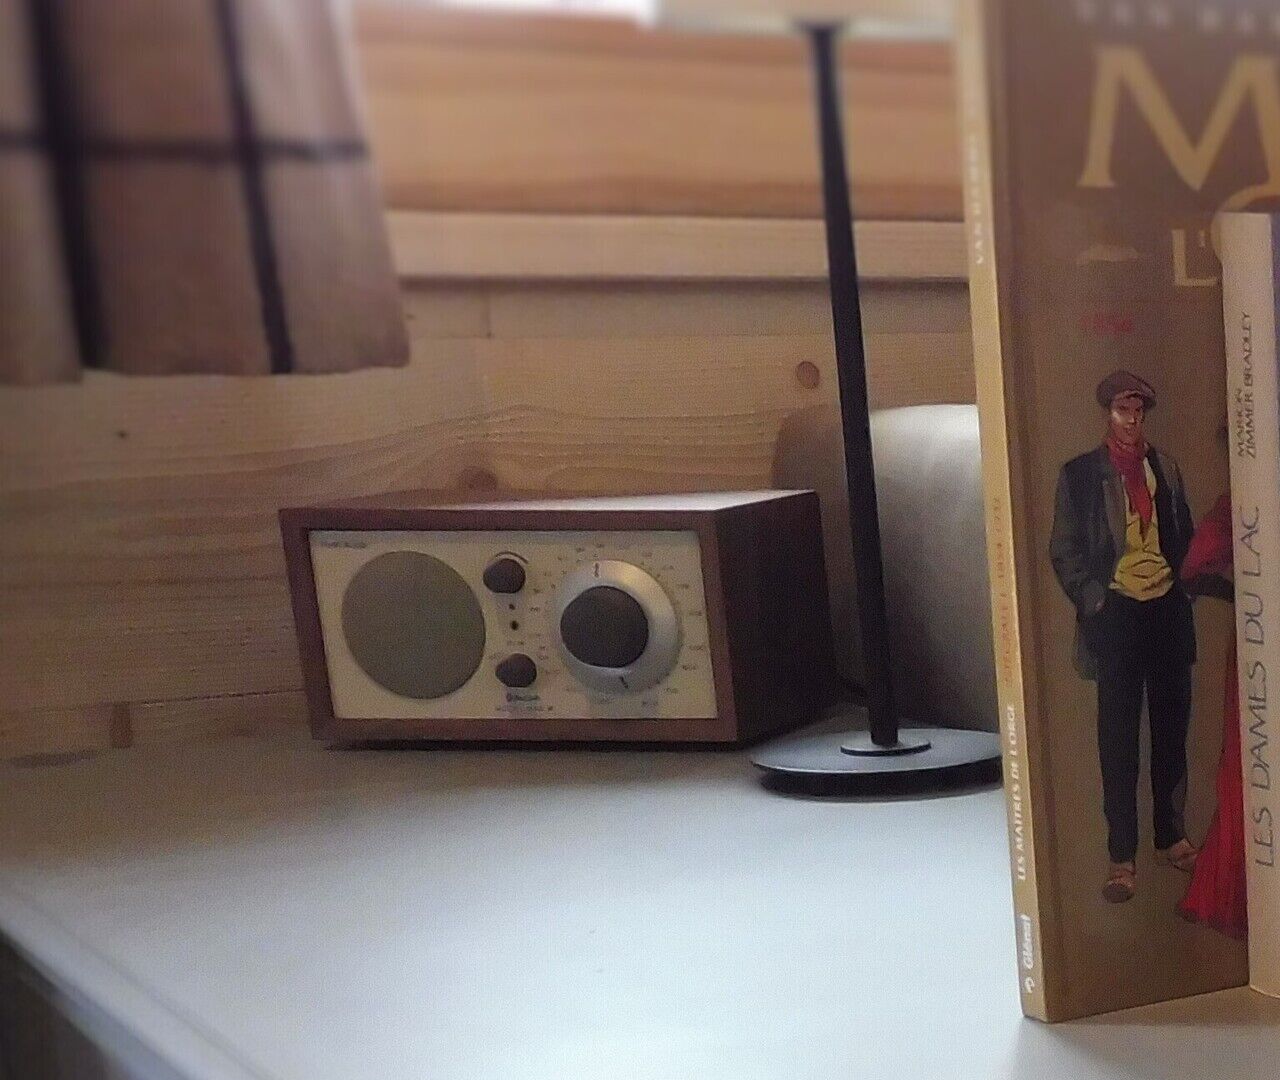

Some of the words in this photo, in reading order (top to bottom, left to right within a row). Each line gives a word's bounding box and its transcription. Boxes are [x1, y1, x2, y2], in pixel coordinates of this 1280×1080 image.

[1236, 505, 1260, 578] LAC
[1239, 591, 1264, 646] DU
[1243, 660, 1271, 793] DAMES
[1252, 806, 1275, 868] LES
